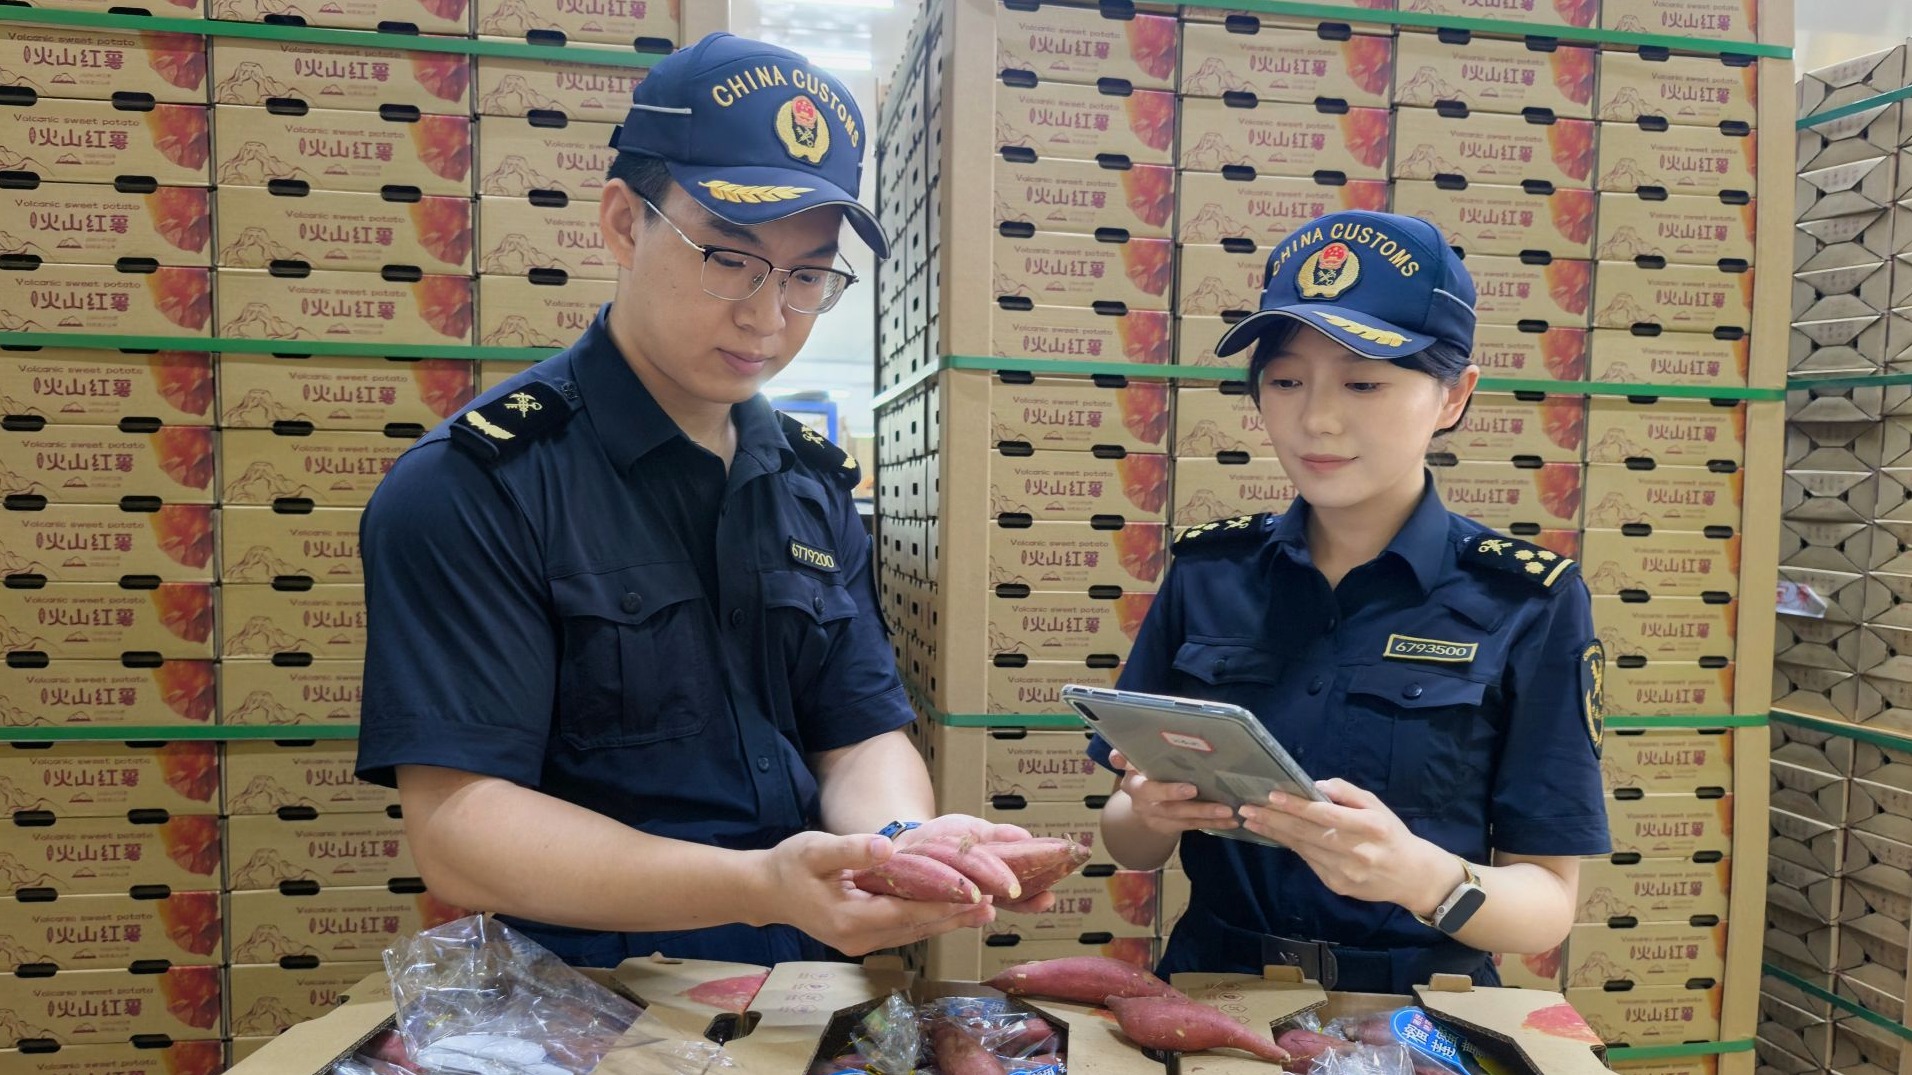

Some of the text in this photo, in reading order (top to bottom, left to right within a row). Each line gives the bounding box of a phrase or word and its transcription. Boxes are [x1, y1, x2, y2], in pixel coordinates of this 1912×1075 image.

[1668, 12, 1730, 31] 火山红薯
[58, 37, 92, 45] sweet
[97, 38, 135, 47] potato
[1037, 36, 1110, 60] 火山红薯
[33, 46, 124, 70] 火山红薯
[1257, 55, 1327, 77] 火山红薯
[304, 58, 389, 82] 火山红薯
[1469, 65, 1535, 86] 火山红薯
[1667, 84, 1730, 104] 火山红薯
[712, 65, 859, 147] CHINA CUSTOMS
[63, 117, 98, 125] sweet
[102, 119, 139, 127] potato
[1037, 109, 1109, 131] 火山红薯
[38, 128, 128, 151] 火山红薯
[1256, 130, 1325, 151] 火山红薯
[308, 139, 392, 162] 火山红薯
[1466, 142, 1532, 163] 火山红薯
[1666, 155, 1728, 174] 火山红薯
[64, 201, 99, 210] sweet
[103, 203, 140, 211] potato
[1034, 187, 1106, 209] 火山红薯
[40, 212, 128, 234] 火山红薯
[1466, 208, 1533, 227] 火山红薯
[309, 223, 393, 246] 火山红薯
[1665, 223, 1727, 242] 火山红薯
[1272, 223, 1419, 277] CHINA CUSTOMS
[1032, 258, 1104, 278] 火山红薯
[65, 280, 99, 288] sweet
[103, 281, 140, 289] potato
[1476, 282, 1529, 299] 山红薯
[41, 291, 129, 311] 火山红薯
[311, 298, 395, 320] 火山红薯
[1660, 290, 1725, 309] 火山红薯
[1030, 336, 1102, 357] 火山红薯
[1473, 353, 1526, 369] 山红薯
[1657, 358, 1720, 377] 火山红薯
[106, 367, 142, 375] potato
[43, 378, 131, 397] 火山红薯
[312, 385, 396, 404] 火山红薯
[1031, 409, 1102, 427] 火山红薯
[1654, 424, 1716, 442] 火山红薯
[47, 453, 133, 472] 火山红薯
[1032, 479, 1102, 497] 火山红薯
[1454, 488, 1520, 504] 火山红薯
[1653, 488, 1715, 506] 火山红薯
[45, 533, 132, 551] 火山红薯
[791, 543, 835, 568] 6779200
[1028, 550, 1099, 567] 火山红薯
[1647, 557, 1711, 575] 火山红薯
[48, 608, 134, 626] 火山红薯
[1030, 617, 1099, 633] 火山红薯
[1646, 623, 1709, 638] 火山红薯
[1395, 642, 1467, 656] 6793500
[50, 688, 136, 706] 火山红薯
[1643, 689, 1706, 704] 火山红薯
[77, 758, 111, 766] sweet
[114, 758, 150, 766] potato
[1025, 758, 1095, 776] 火山红薯
[1643, 750, 1706, 766] 火山红薯
[53, 769, 138, 787] 火山红薯
[1642, 822, 1704, 837] 火山红薯
[56, 844, 141, 862] 火山红薯
[317, 840, 399, 859] 火山红薯
[1639, 881, 1702, 896] 火山红薯
[1044, 898, 1092, 914] 山红薯
[79, 914, 113, 922] sweet
[116, 913, 152, 922] potato
[318, 916, 399, 935] 火山红薯
[56, 924, 141, 944] 火山红薯
[1636, 945, 1698, 960] 火山红薯
[80, 988, 114, 996] sweet
[117, 987, 153, 995] potato
[57, 998, 141, 1019] 火山红薯
[1629, 1006, 1693, 1023] 火山红薯
